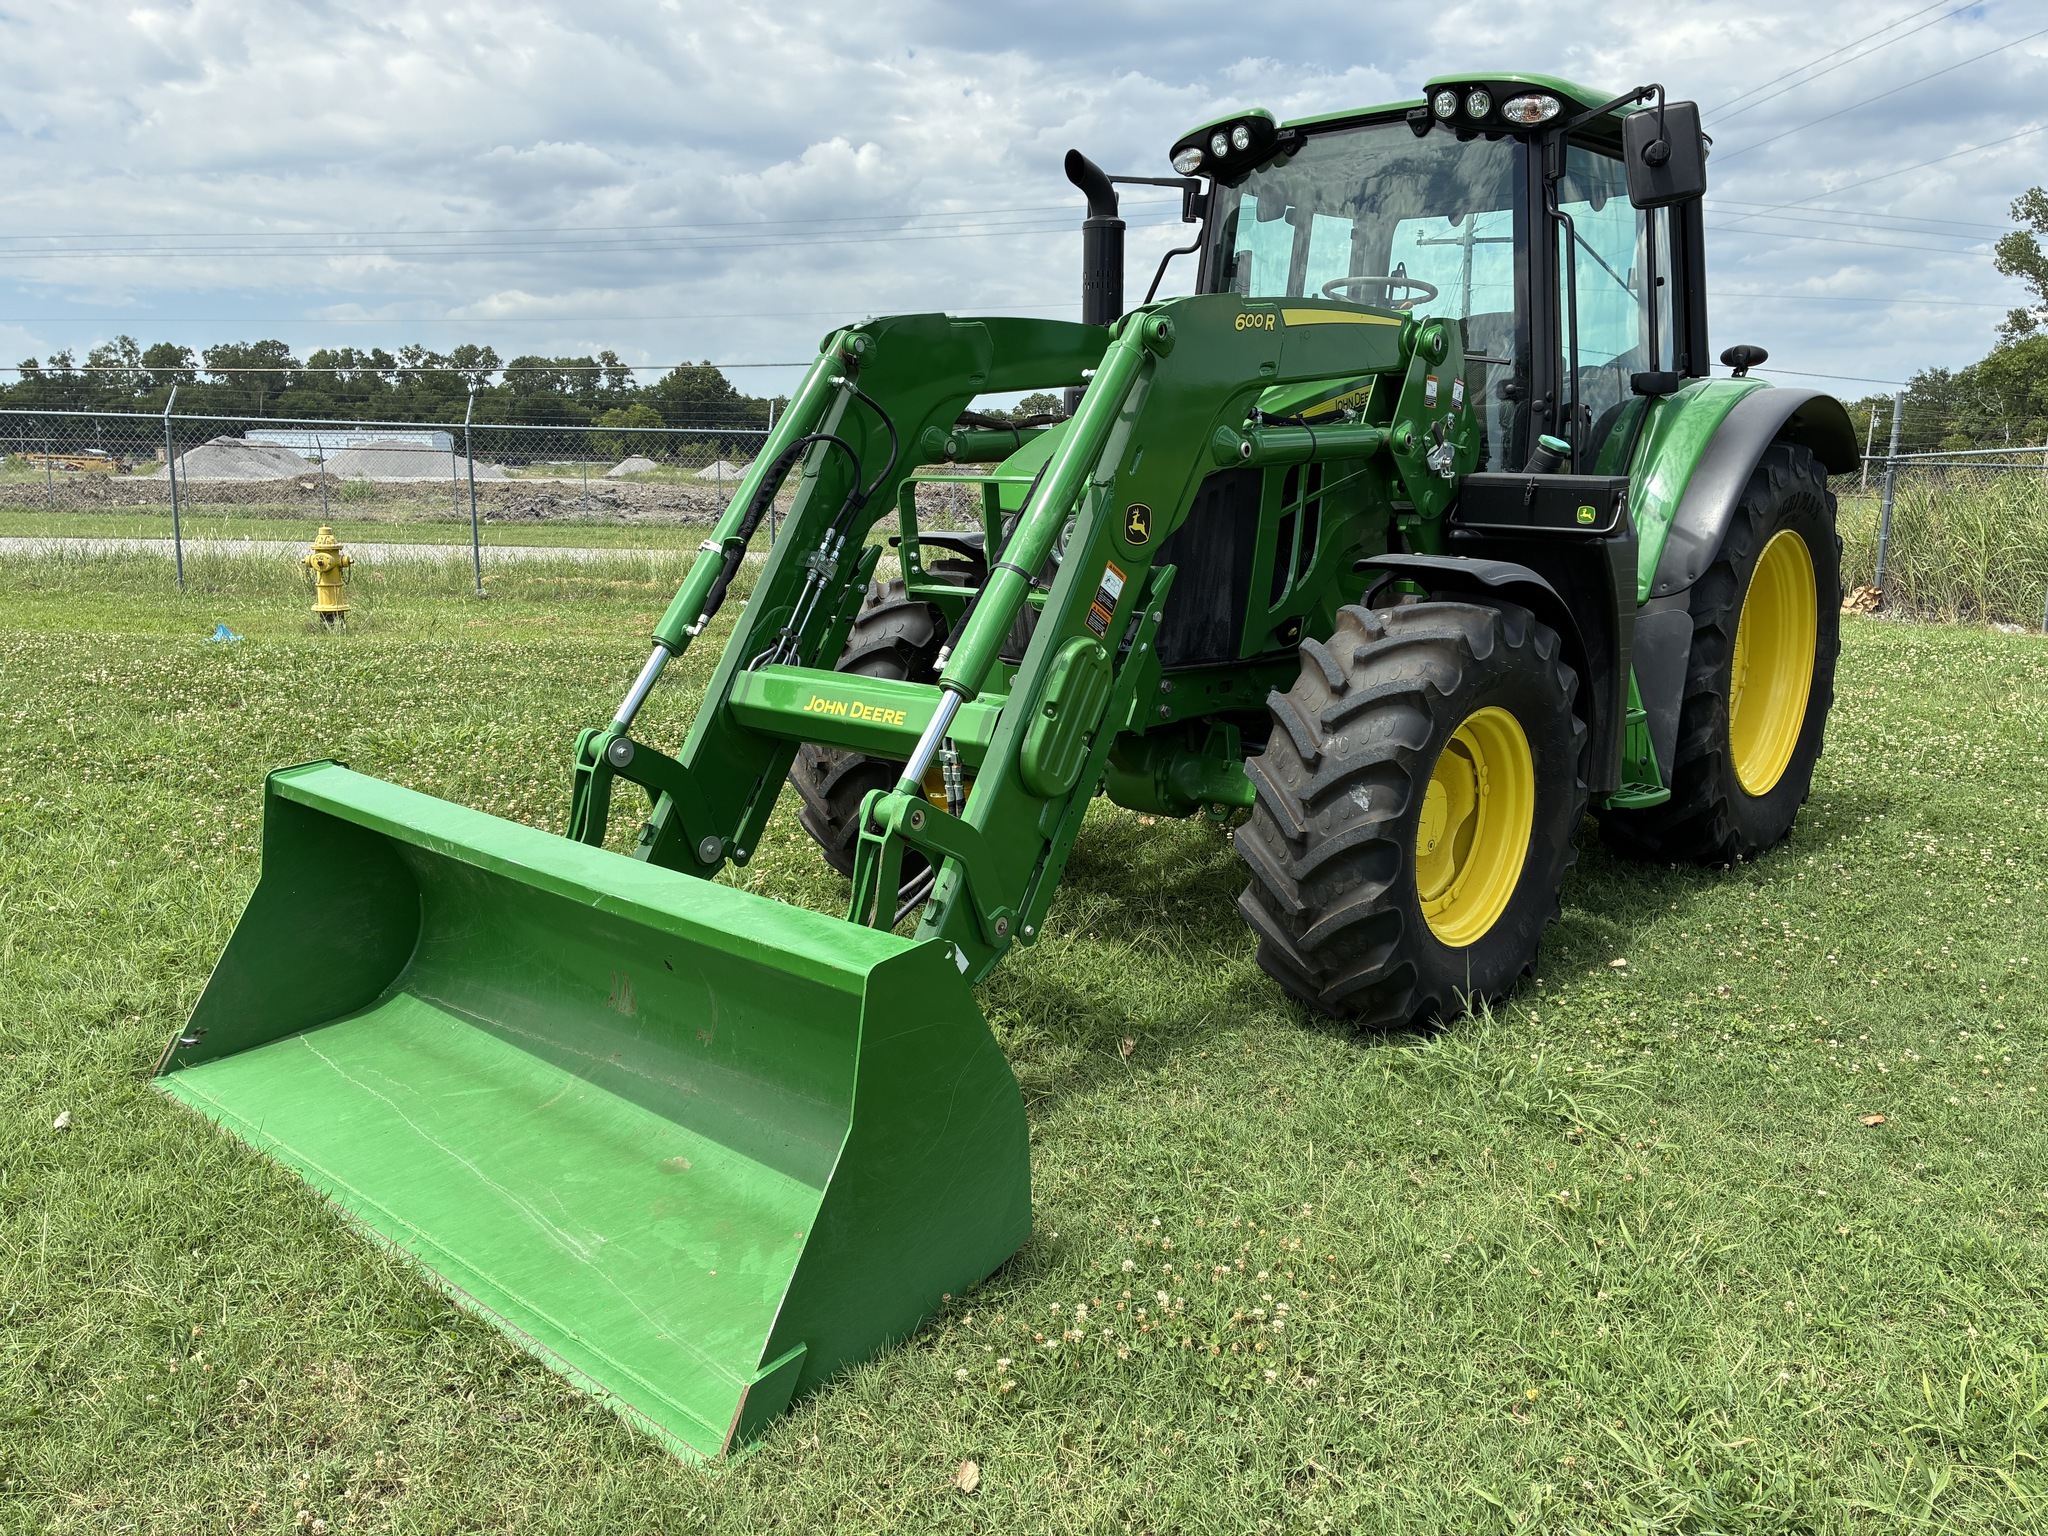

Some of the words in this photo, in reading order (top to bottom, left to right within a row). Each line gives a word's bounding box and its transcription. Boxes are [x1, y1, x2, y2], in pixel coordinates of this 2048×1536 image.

[1335, 396, 1354, 411] JOHN
[1354, 391, 1370, 407] DEE
[803, 695, 848, 716] JOHN
[849, 701, 906, 725] DEERE
